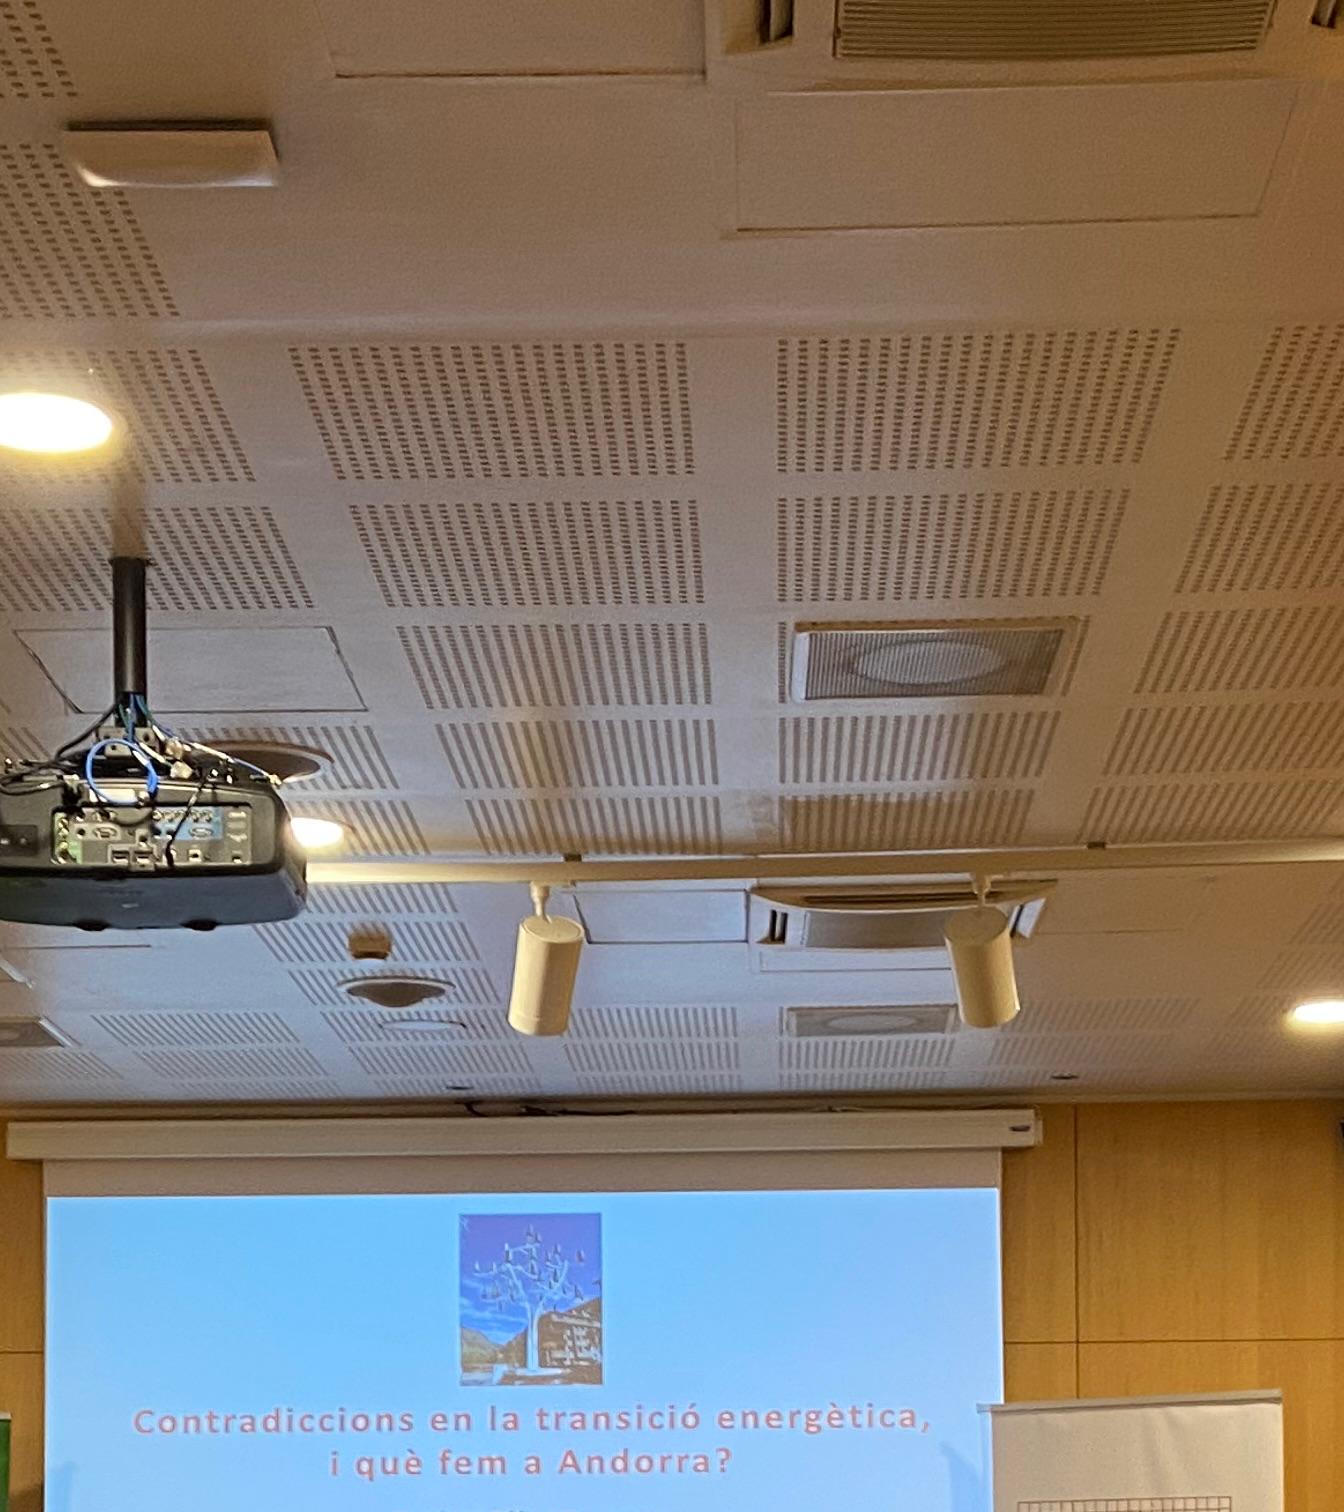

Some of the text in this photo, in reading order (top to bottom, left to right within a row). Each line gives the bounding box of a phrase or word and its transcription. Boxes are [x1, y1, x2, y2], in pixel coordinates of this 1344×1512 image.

[133, 1402, 930, 1435] Contradiccions en la transició energètica,
[331, 1447, 732, 1483] i què fem a Andorra?
